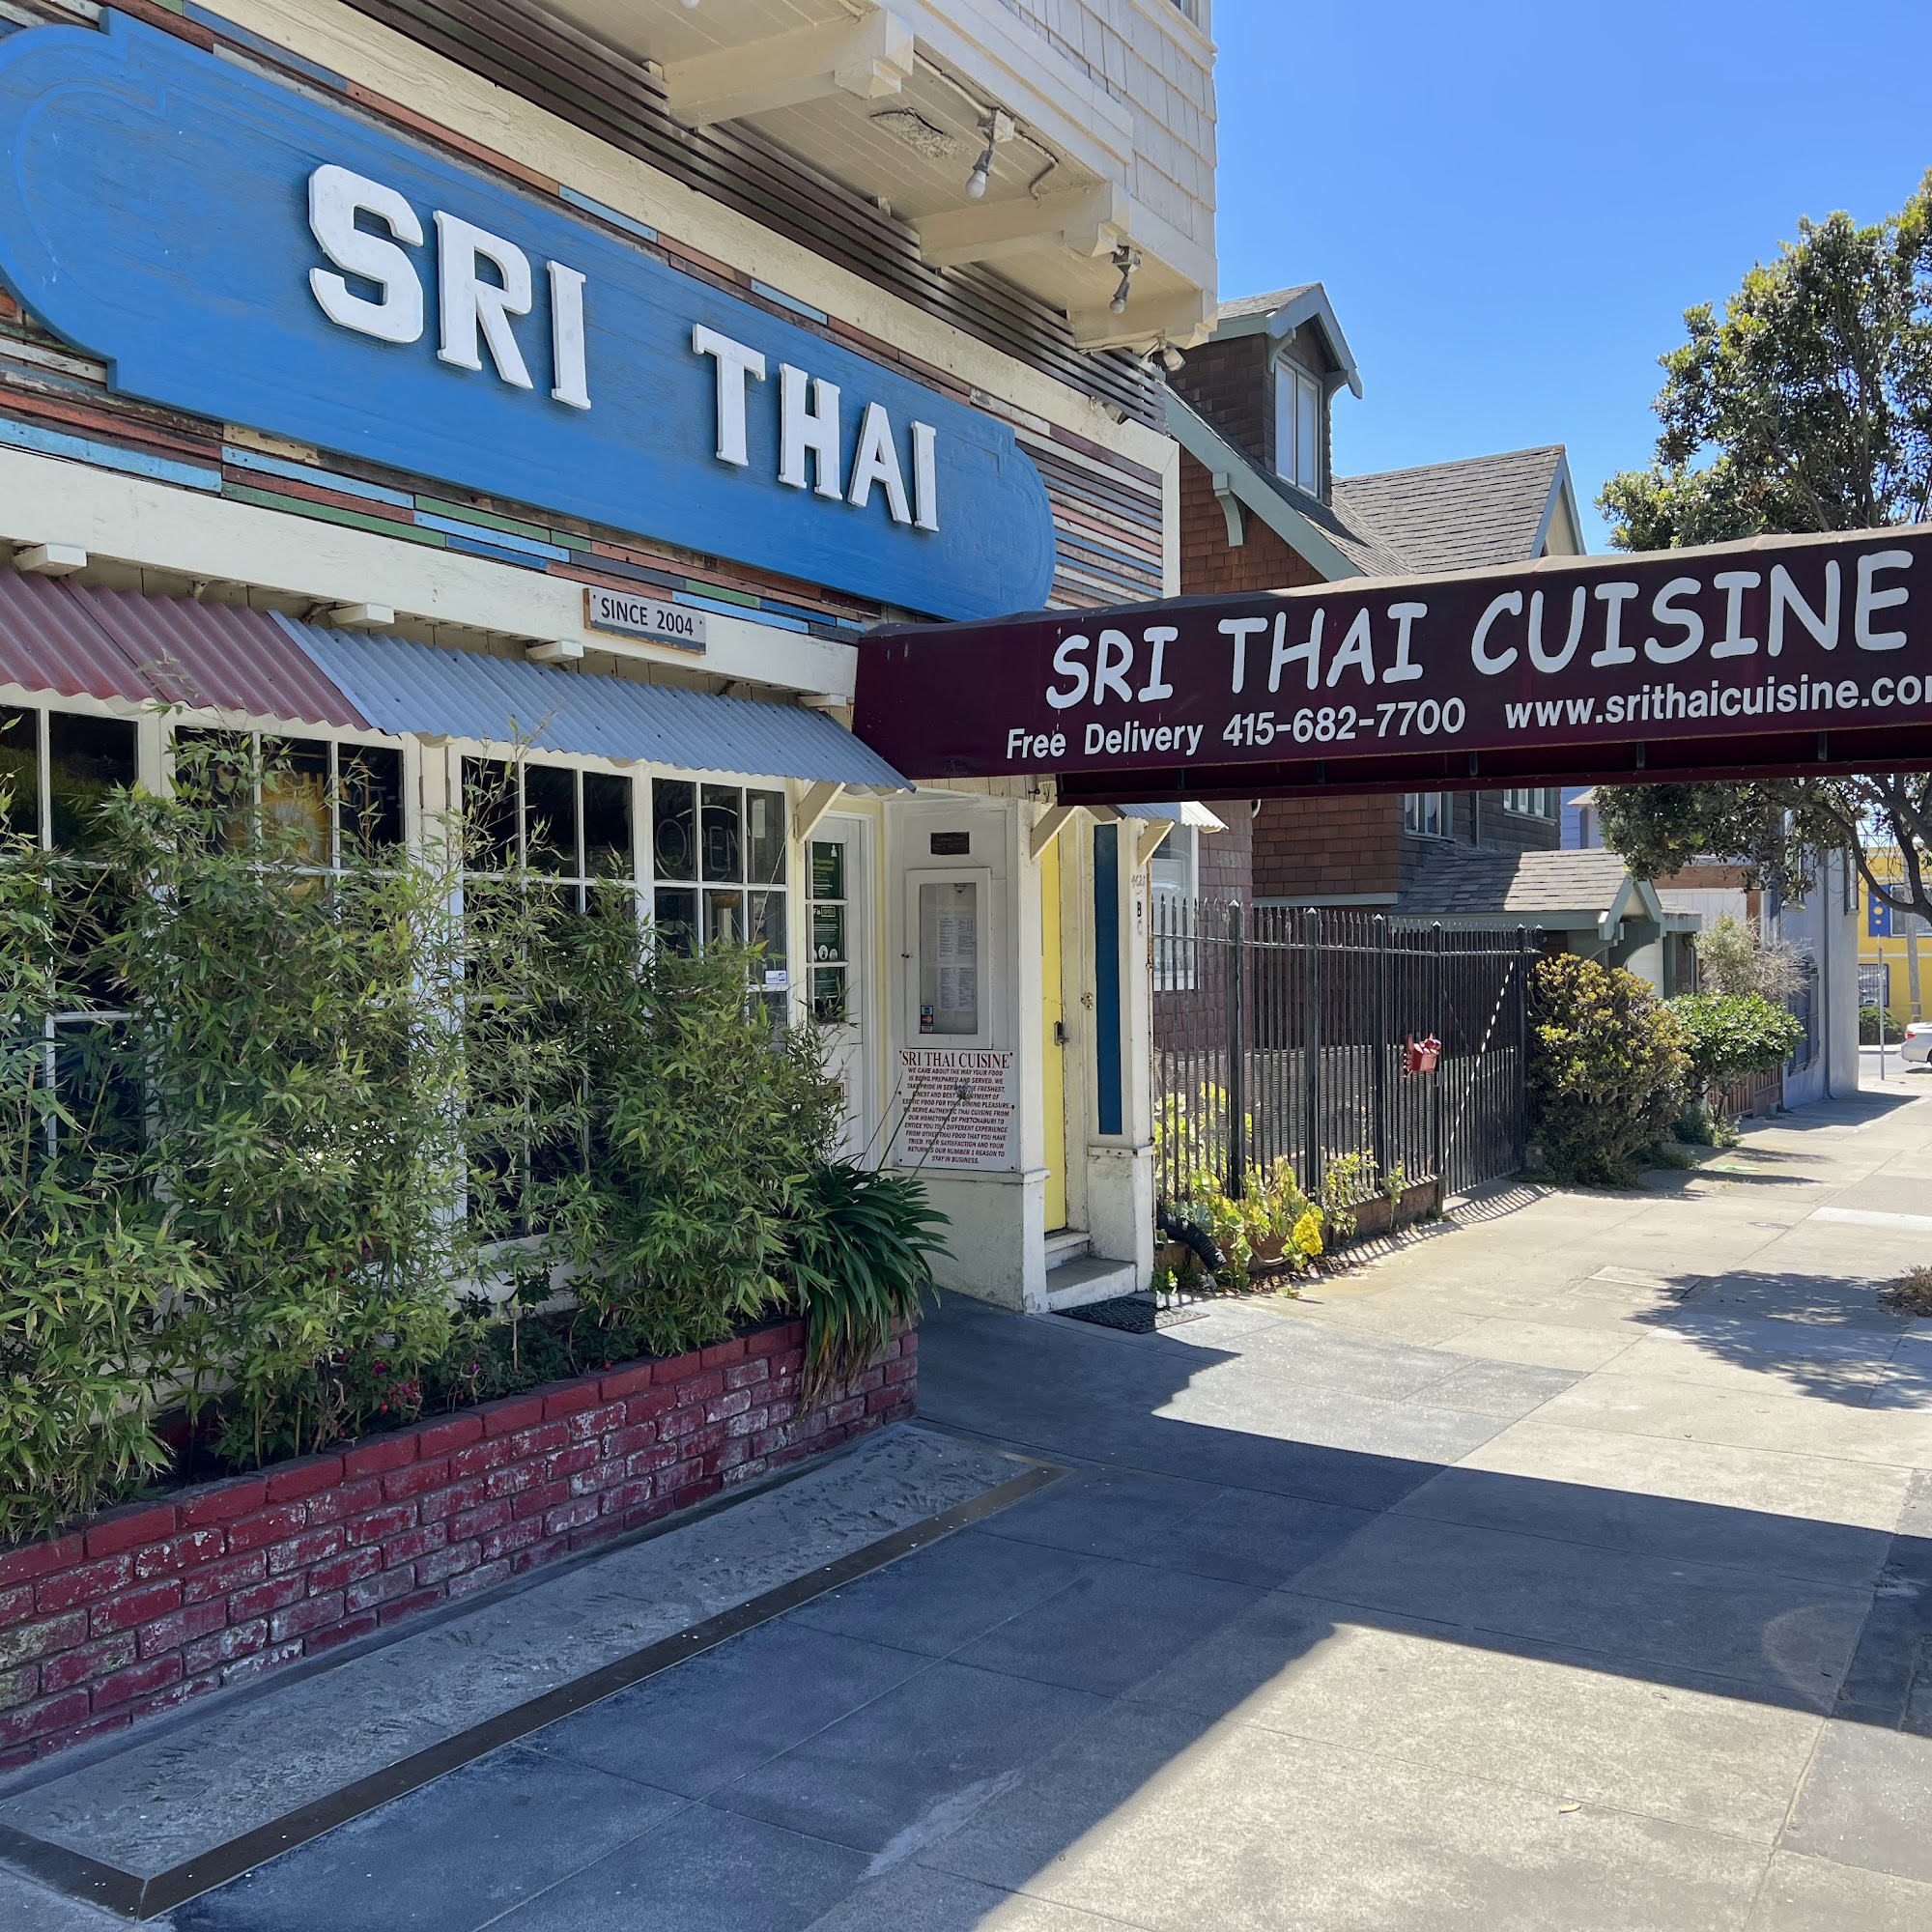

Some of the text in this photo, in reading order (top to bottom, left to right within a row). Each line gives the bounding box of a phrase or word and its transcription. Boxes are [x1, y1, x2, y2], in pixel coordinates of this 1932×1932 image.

[308, 163, 940, 532] SRI THAI
[601, 597, 694, 637] SINCE 2004
[1045, 549, 1914, 709] SRI THAI CUISINE
[1006, 673, 1932, 759] Free Delivery 415-682-7700 www.srithaicuisine.co
[902, 1051, 1009, 1068] SRI THAI CUISINE
